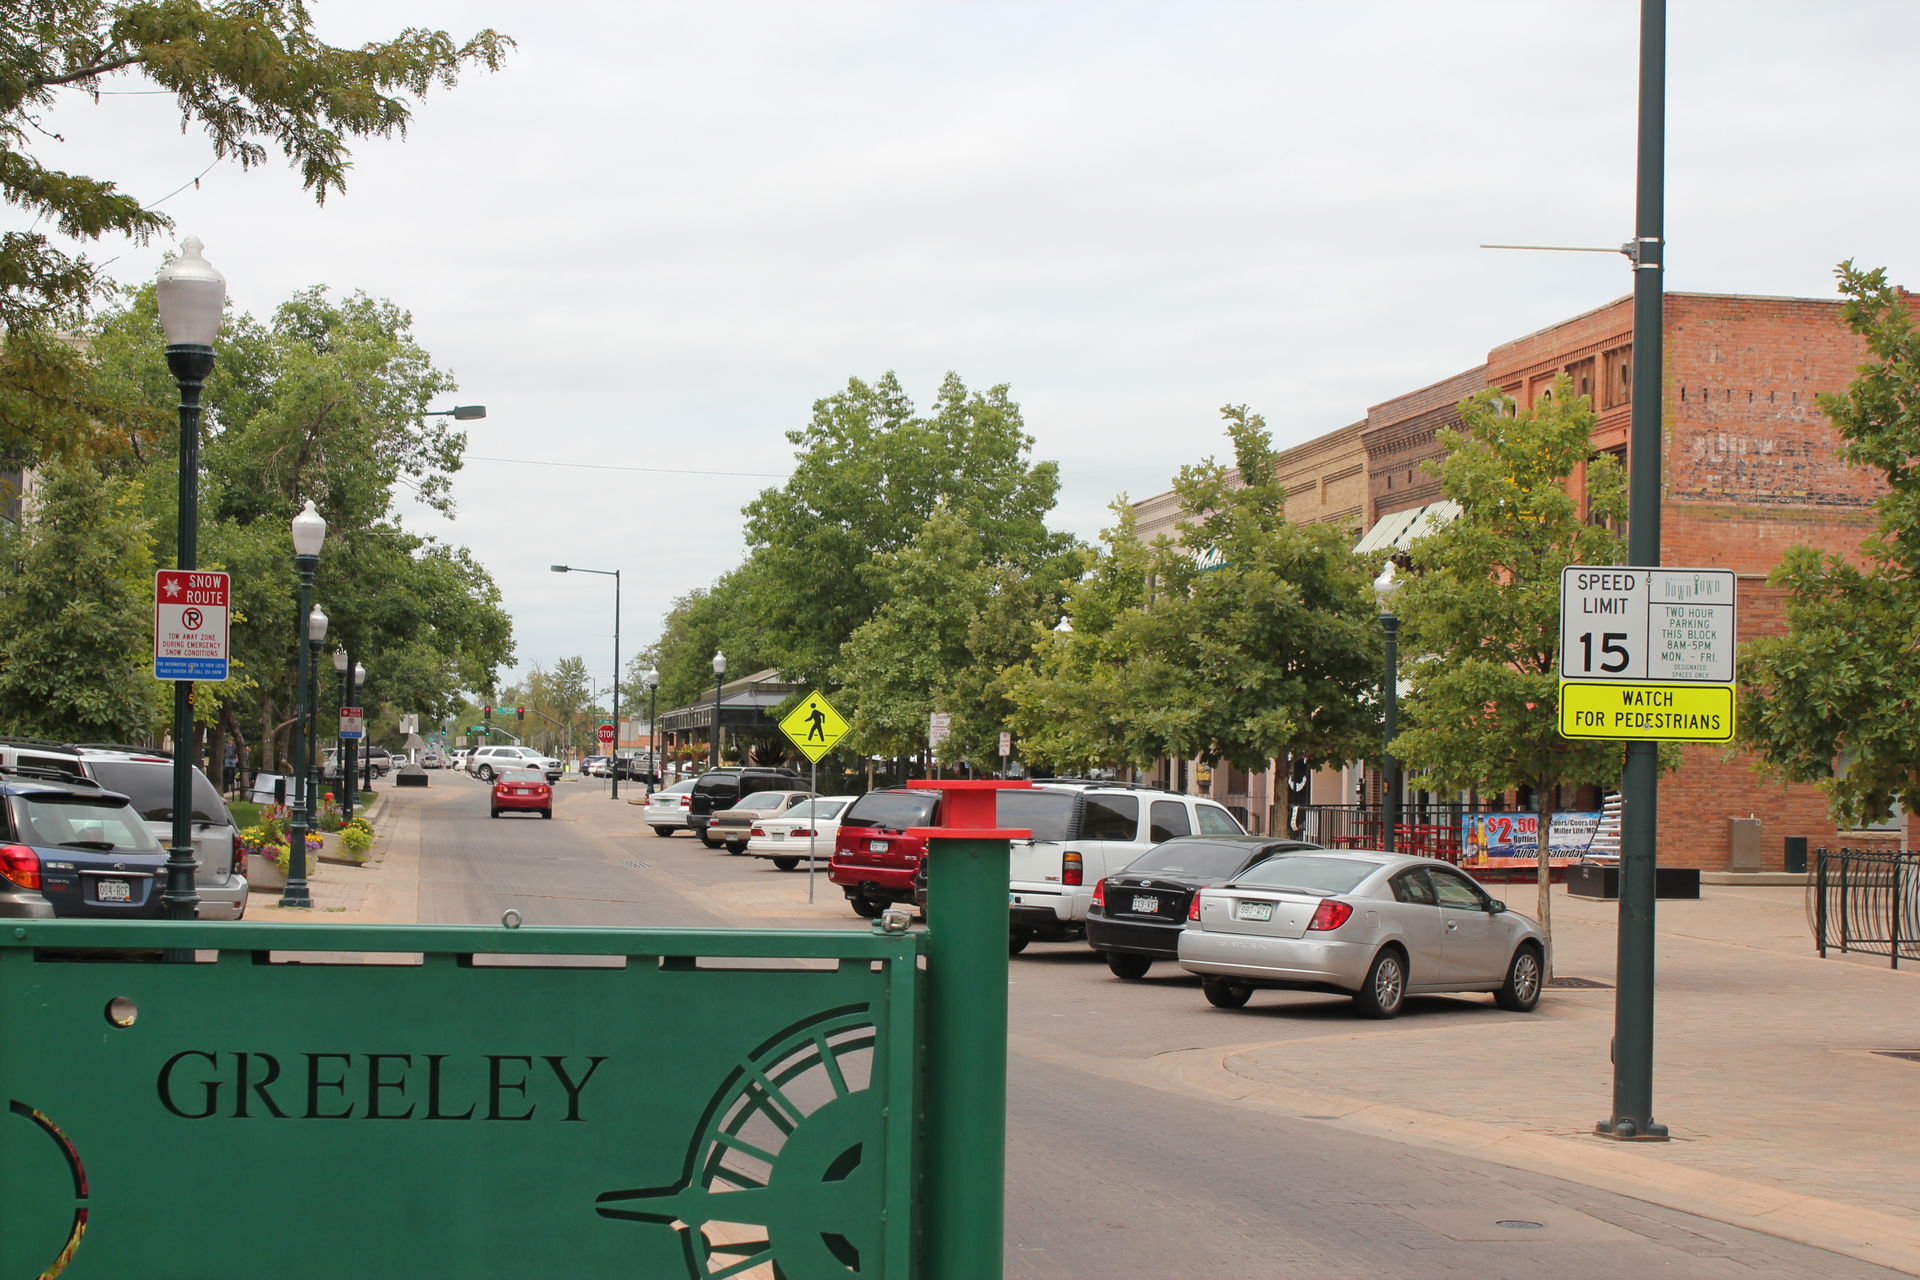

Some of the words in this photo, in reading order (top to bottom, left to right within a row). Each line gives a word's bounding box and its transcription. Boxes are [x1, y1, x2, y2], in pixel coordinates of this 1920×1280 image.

[189, 574, 222, 589] SNOW
[1578, 574, 1635, 591] SPEED
[186, 590, 223, 605] ROUTE
[1583, 597, 1629, 615] LIMIT
[1665, 606, 1685, 618] TWO
[1688, 608, 1714, 618] HOUR
[1669, 619, 1710, 629] PARKING
[168, 632, 180, 640] TOW
[183, 633, 198, 641] AWAY
[1662, 629, 1683, 639] THIS
[1687, 630, 1717, 640] BLOCK
[162, 641, 185, 649] DURING
[187, 641, 221, 649] EMERGENCY
[1667, 640, 1712, 650] 8AM-5PM
[184, 649, 218, 657] CONDITIONS
[1579, 632, 1630, 673] 15
[1661, 651, 1685, 662] MON.
[1700, 652, 1719, 663] FRI.
[1622, 690, 1673, 707] WATCH
[1575, 711, 1605, 727] FOR
[1615, 712, 1721, 730] PEDESTRIANS
[1487, 816, 1537, 844] $2.50
[1513, 835, 1537, 844] Bottles
[1547, 848, 1586, 859] Saturday
[156, 1049, 609, 1122] GREELEY
